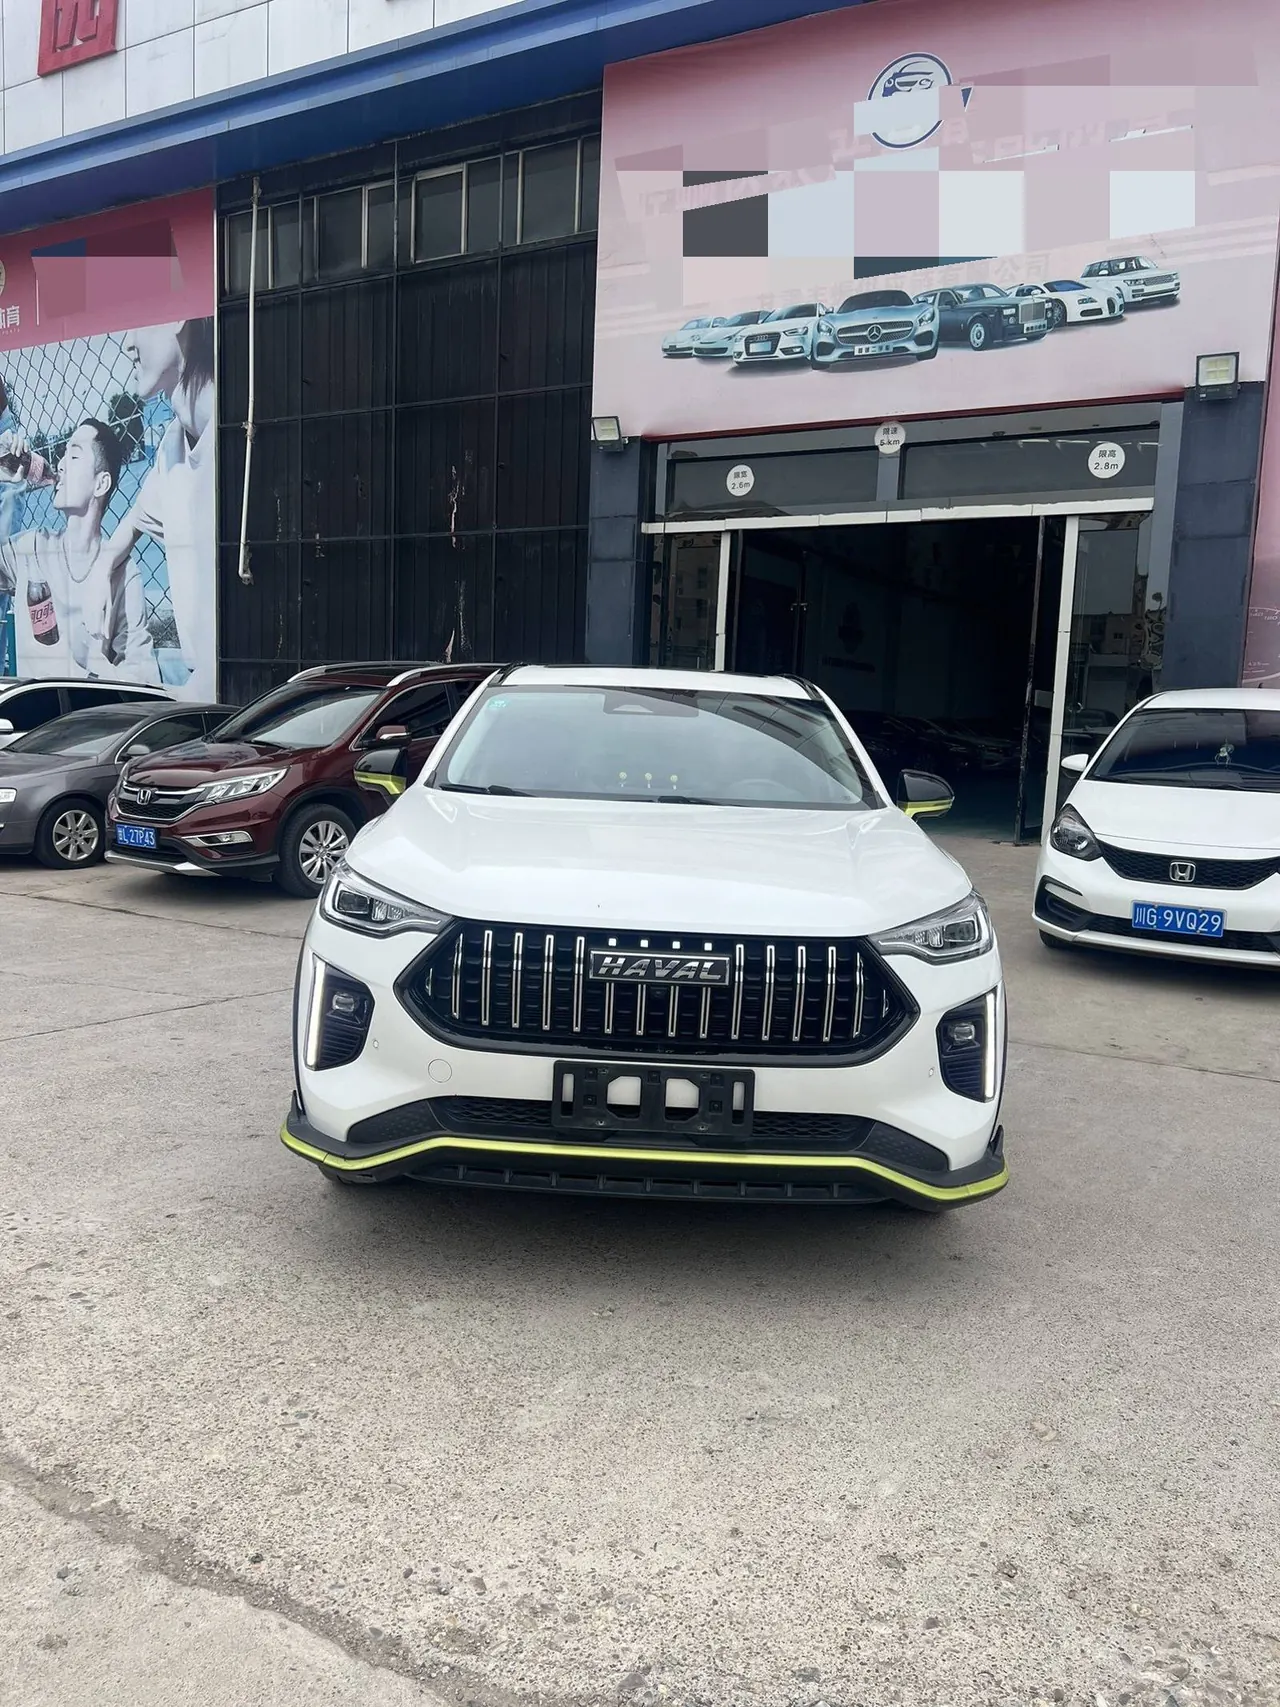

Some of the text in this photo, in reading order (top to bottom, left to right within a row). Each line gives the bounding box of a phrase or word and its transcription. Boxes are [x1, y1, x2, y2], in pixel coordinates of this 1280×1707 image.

[1098, 449, 1117, 458] 限高
[1093, 462, 1119, 470] 2.8m
[731, 481, 751, 490] 2.6m
[598, 956, 722, 980] HAVAL
